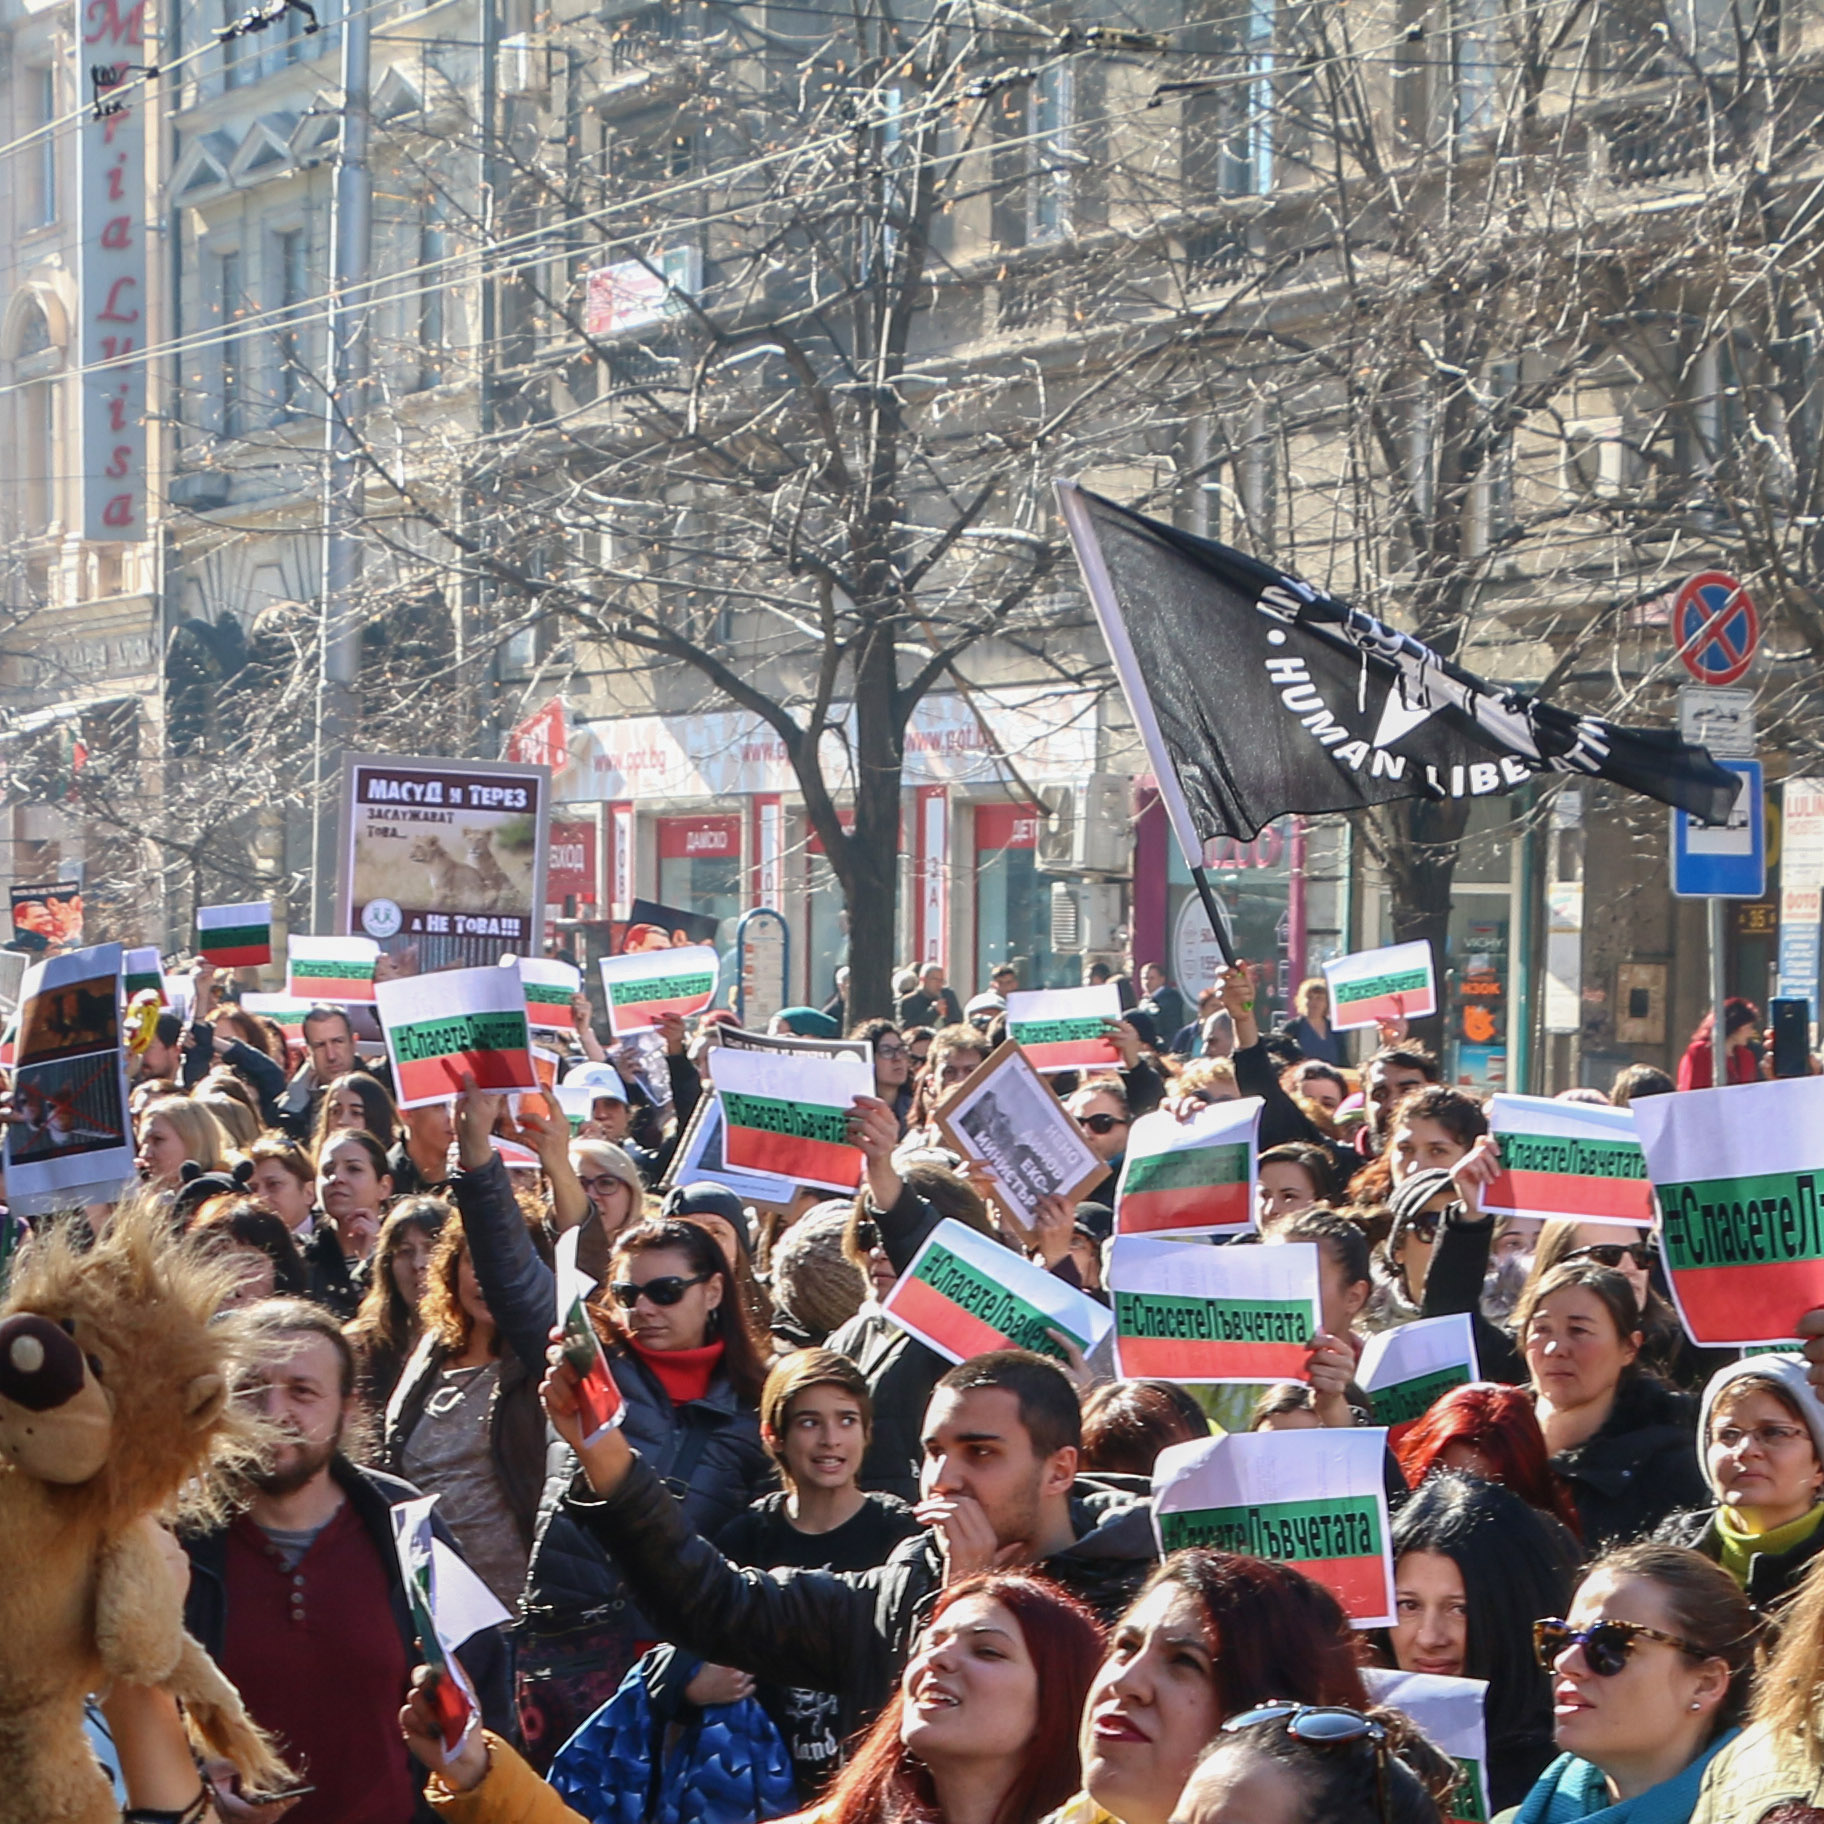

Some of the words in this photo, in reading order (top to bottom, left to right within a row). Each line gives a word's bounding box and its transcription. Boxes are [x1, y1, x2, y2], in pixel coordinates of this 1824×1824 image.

[1264, 656, 1406, 779] HUMAN
[468, 784, 528, 809] ТЕРЕЗ
[366, 806, 456, 825] ЗАСЛУЖАВАТ
[426, 914, 450, 933] НЕ
[973, 1130, 1038, 1208] МИНИСТЪР
[1122, 1295, 1306, 1342] #СпасетеЛъвчетата
